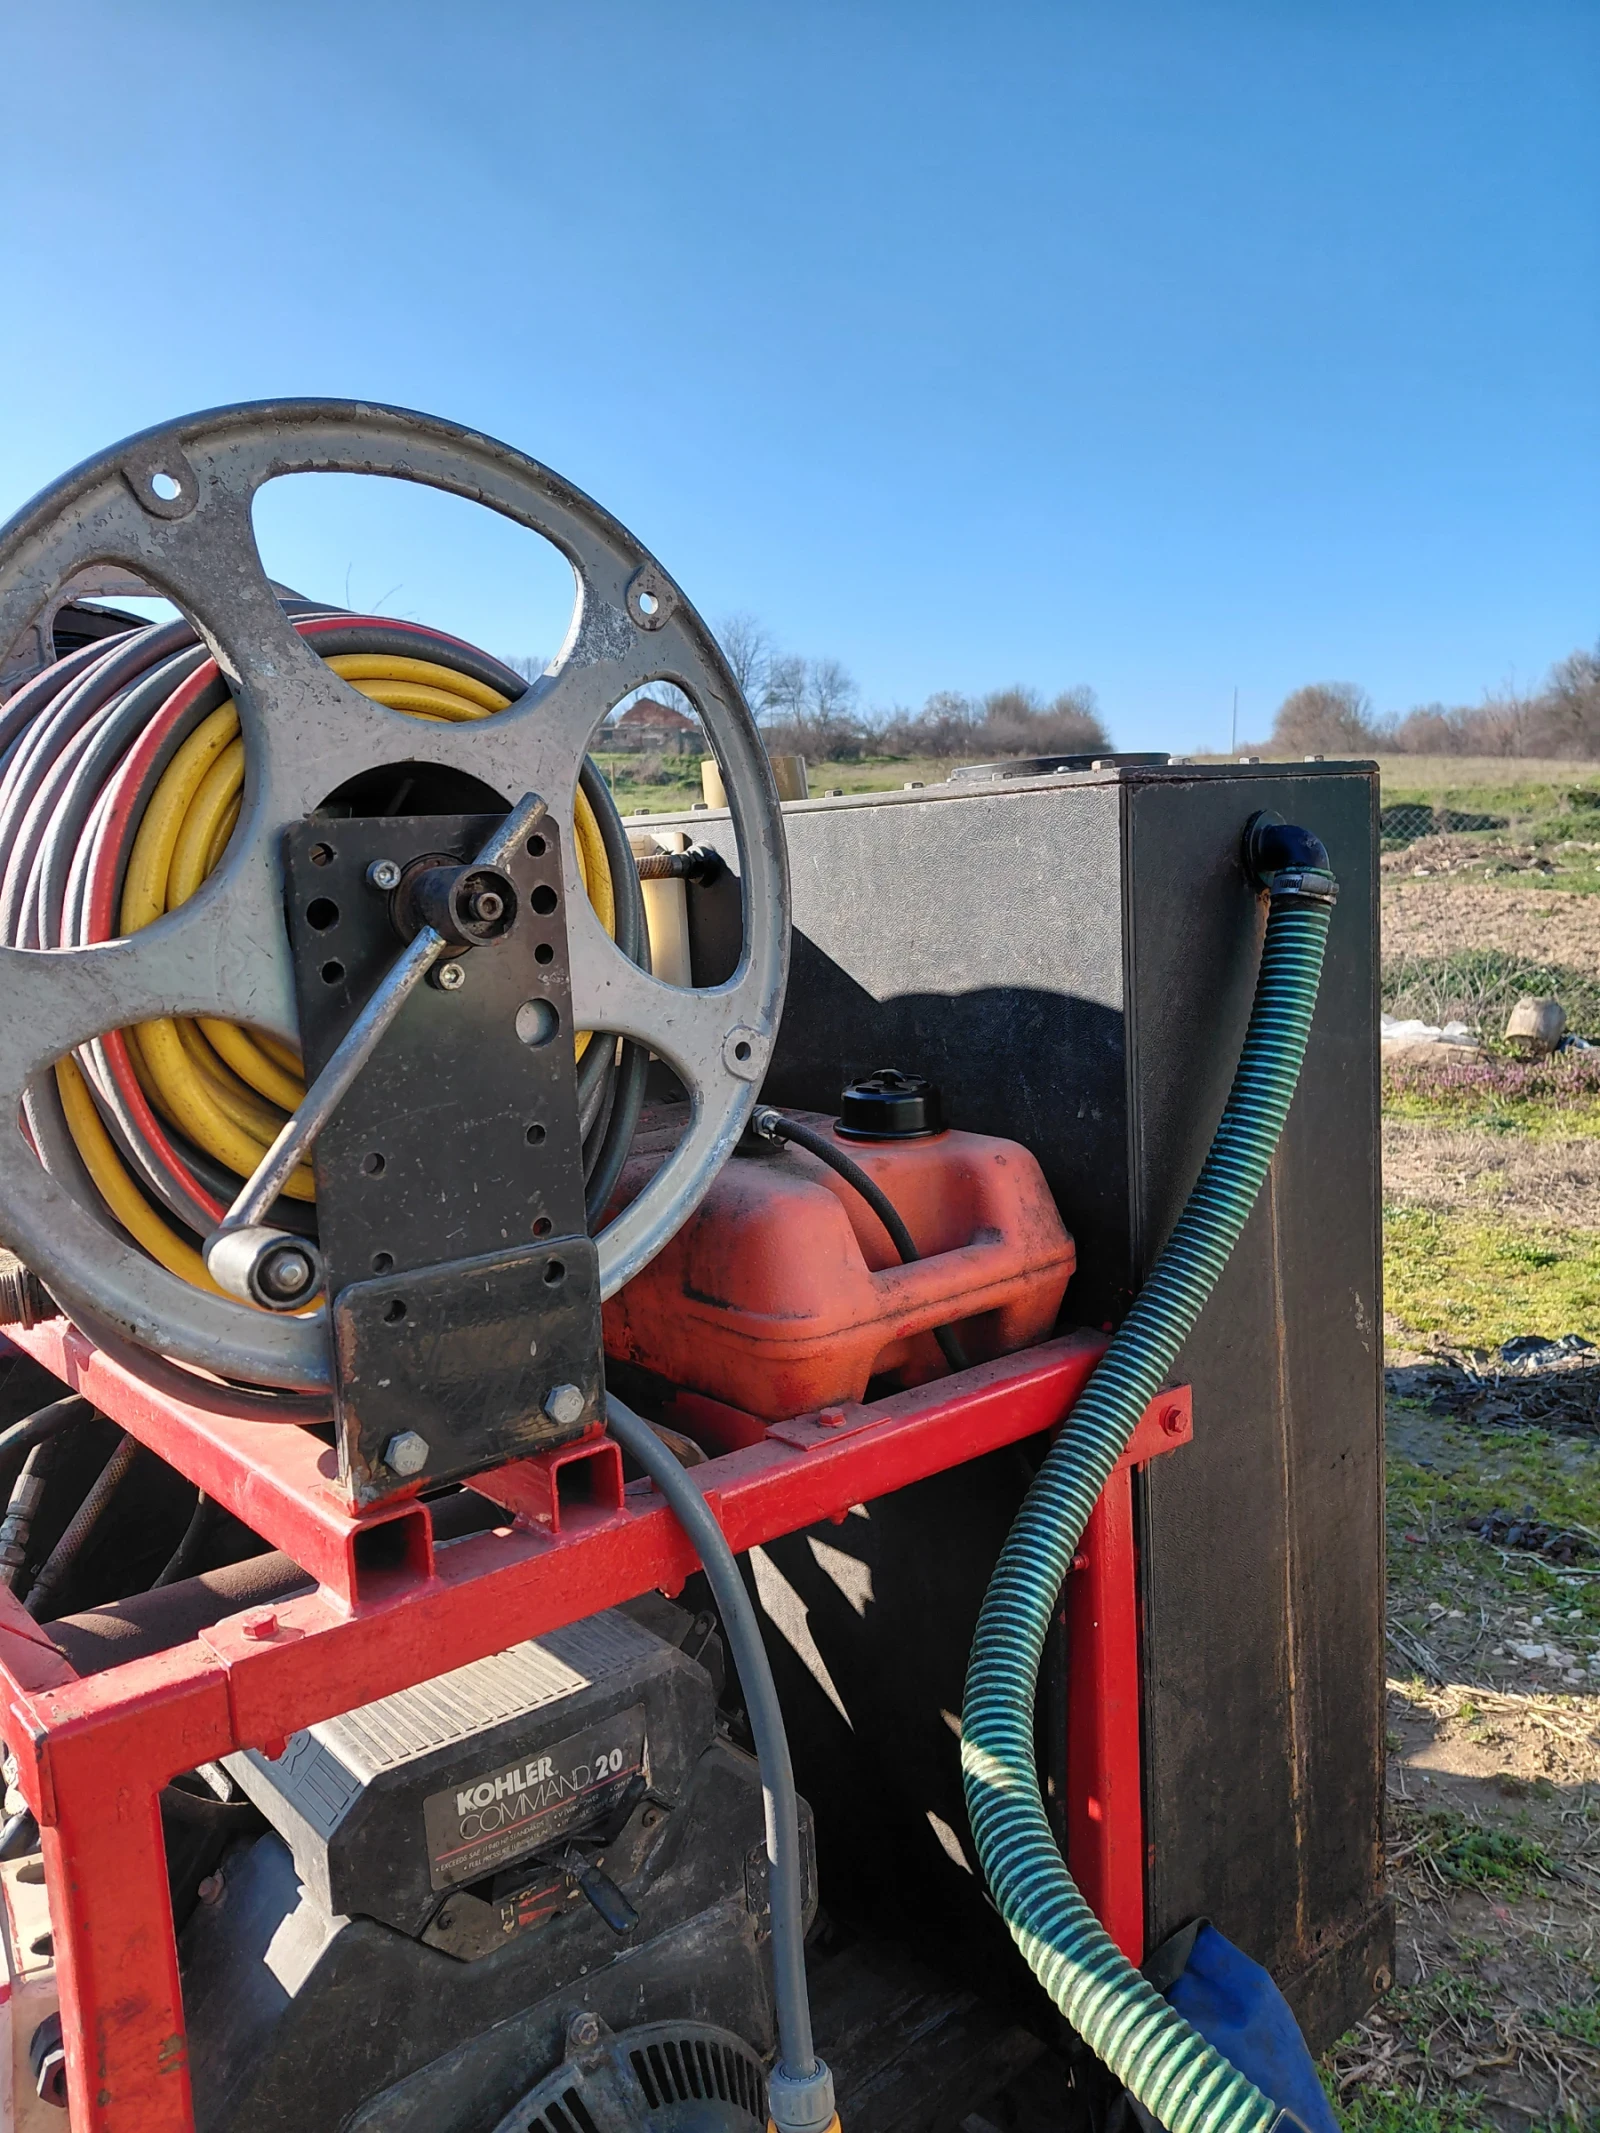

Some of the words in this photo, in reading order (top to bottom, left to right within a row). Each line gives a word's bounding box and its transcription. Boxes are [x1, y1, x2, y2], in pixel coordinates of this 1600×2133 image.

[456, 1755, 555, 1817] KOHLER
[459, 1765, 591, 1841] COMMAND
[594, 1747, 623, 1781] 20
[440, 1855, 468, 1872] EXCEEDS
